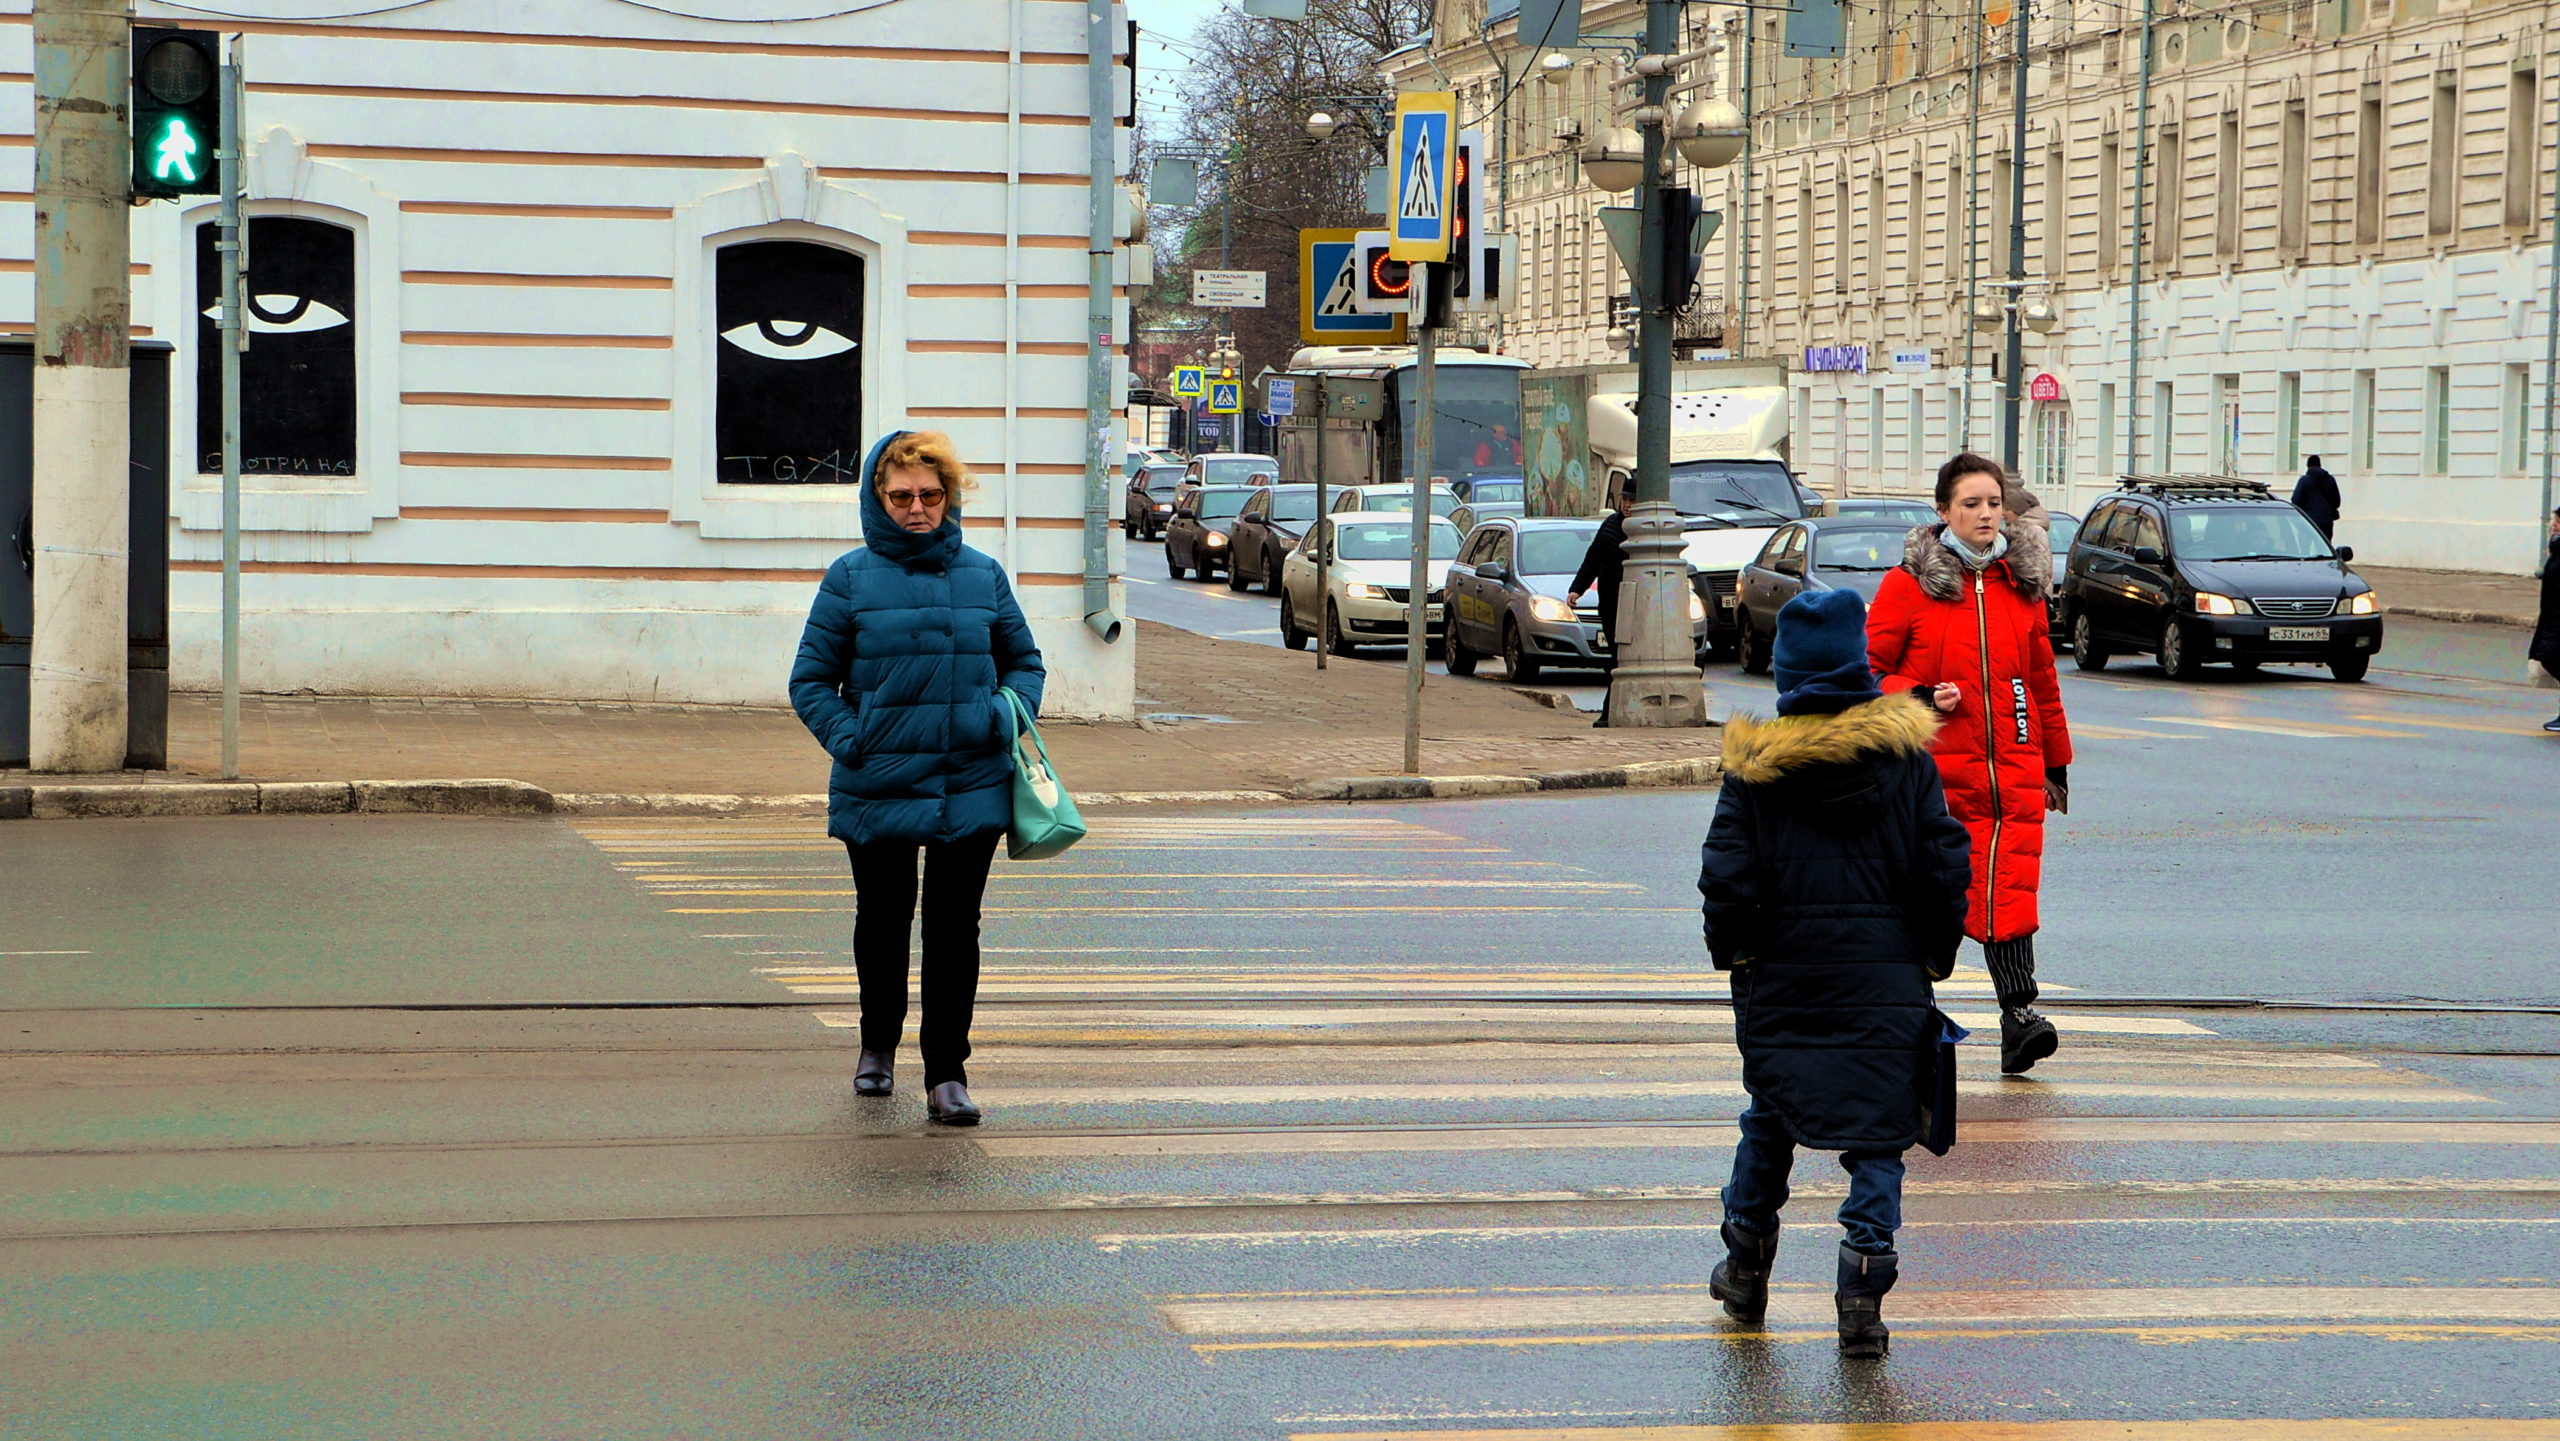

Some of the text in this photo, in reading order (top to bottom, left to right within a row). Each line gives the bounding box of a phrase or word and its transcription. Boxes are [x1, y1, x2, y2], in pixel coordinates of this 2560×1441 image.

[2033, 382, 2056, 398] ЦВЕТЫ
[206, 452, 350, 474] СОТРИ НА
[2012, 678, 2028, 743] LOVE LOVE
